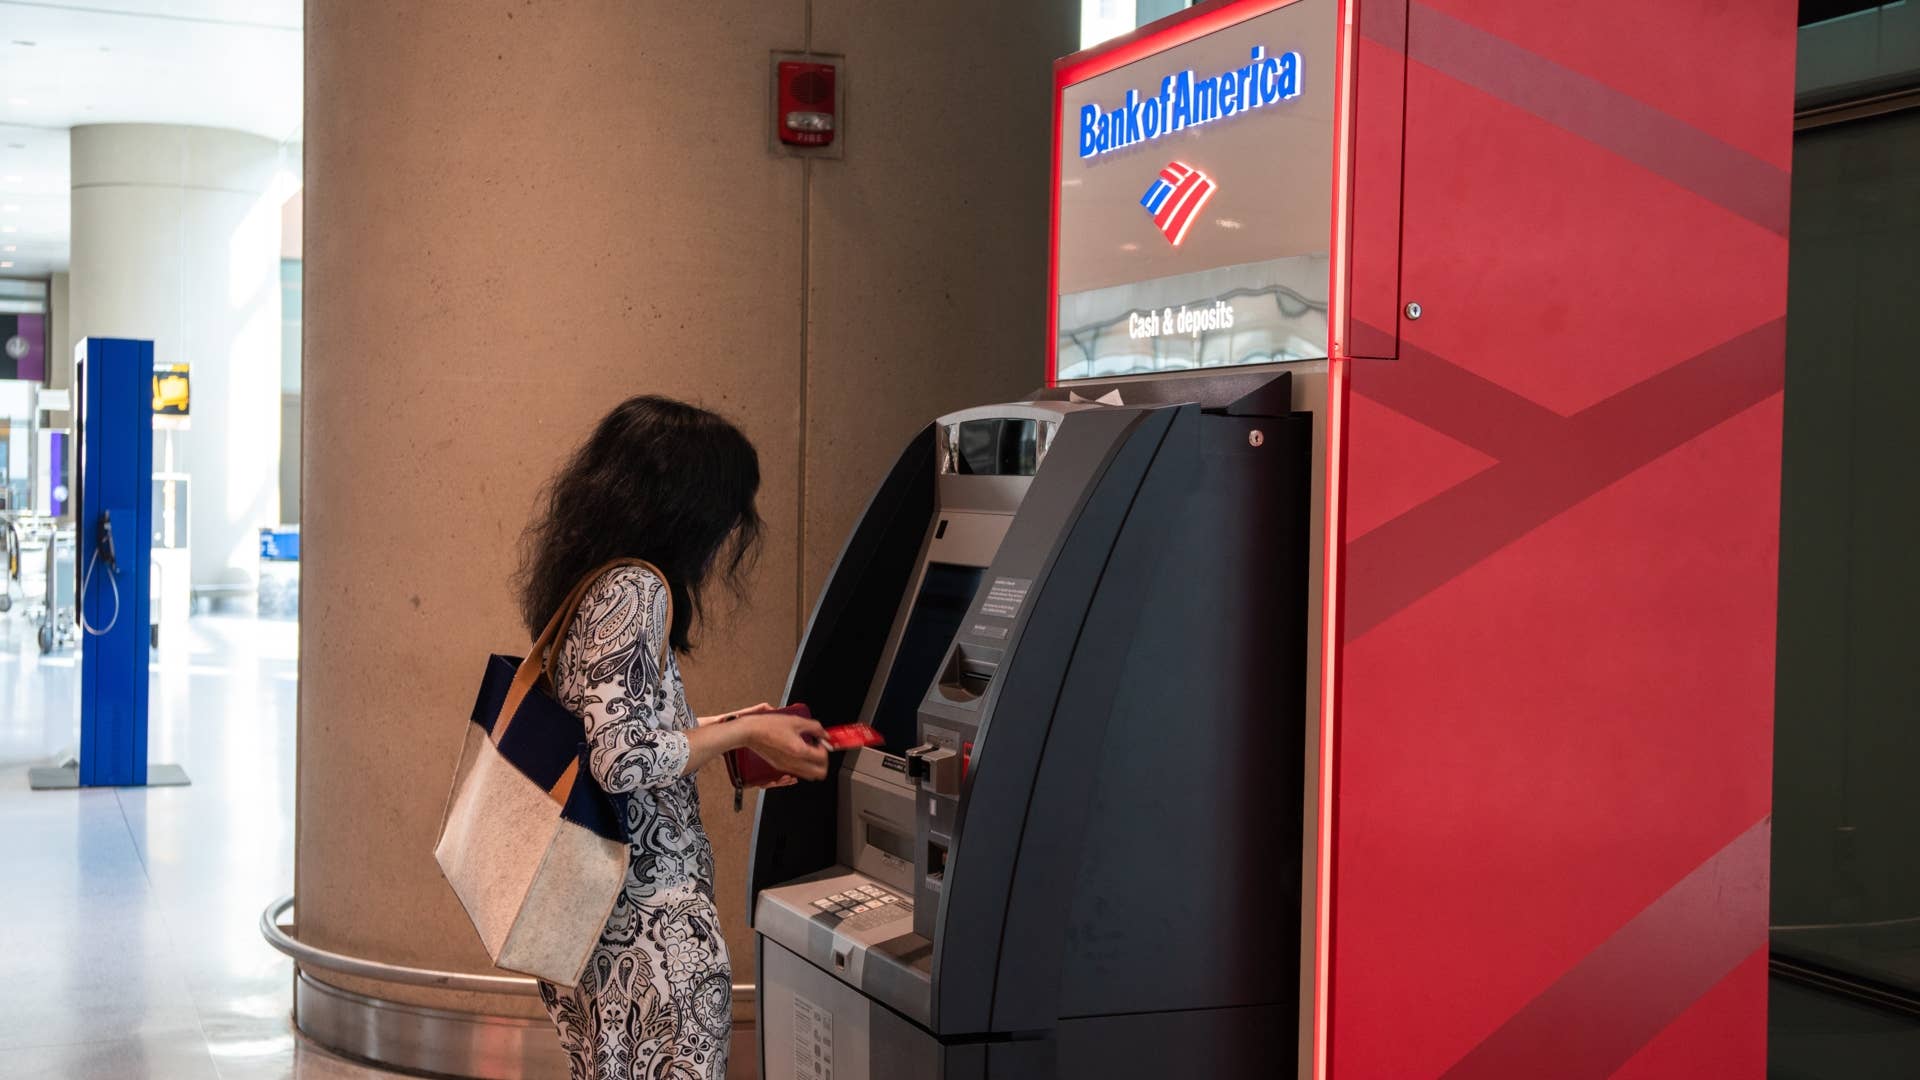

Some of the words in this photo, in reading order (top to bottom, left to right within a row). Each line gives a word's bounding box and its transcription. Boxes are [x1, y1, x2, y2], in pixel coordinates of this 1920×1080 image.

[796, 132, 824, 143] FIRE
[1129, 310, 1160, 339] Cash
[1162, 308, 1174, 335] &
[1177, 300, 1234, 338] deposits
